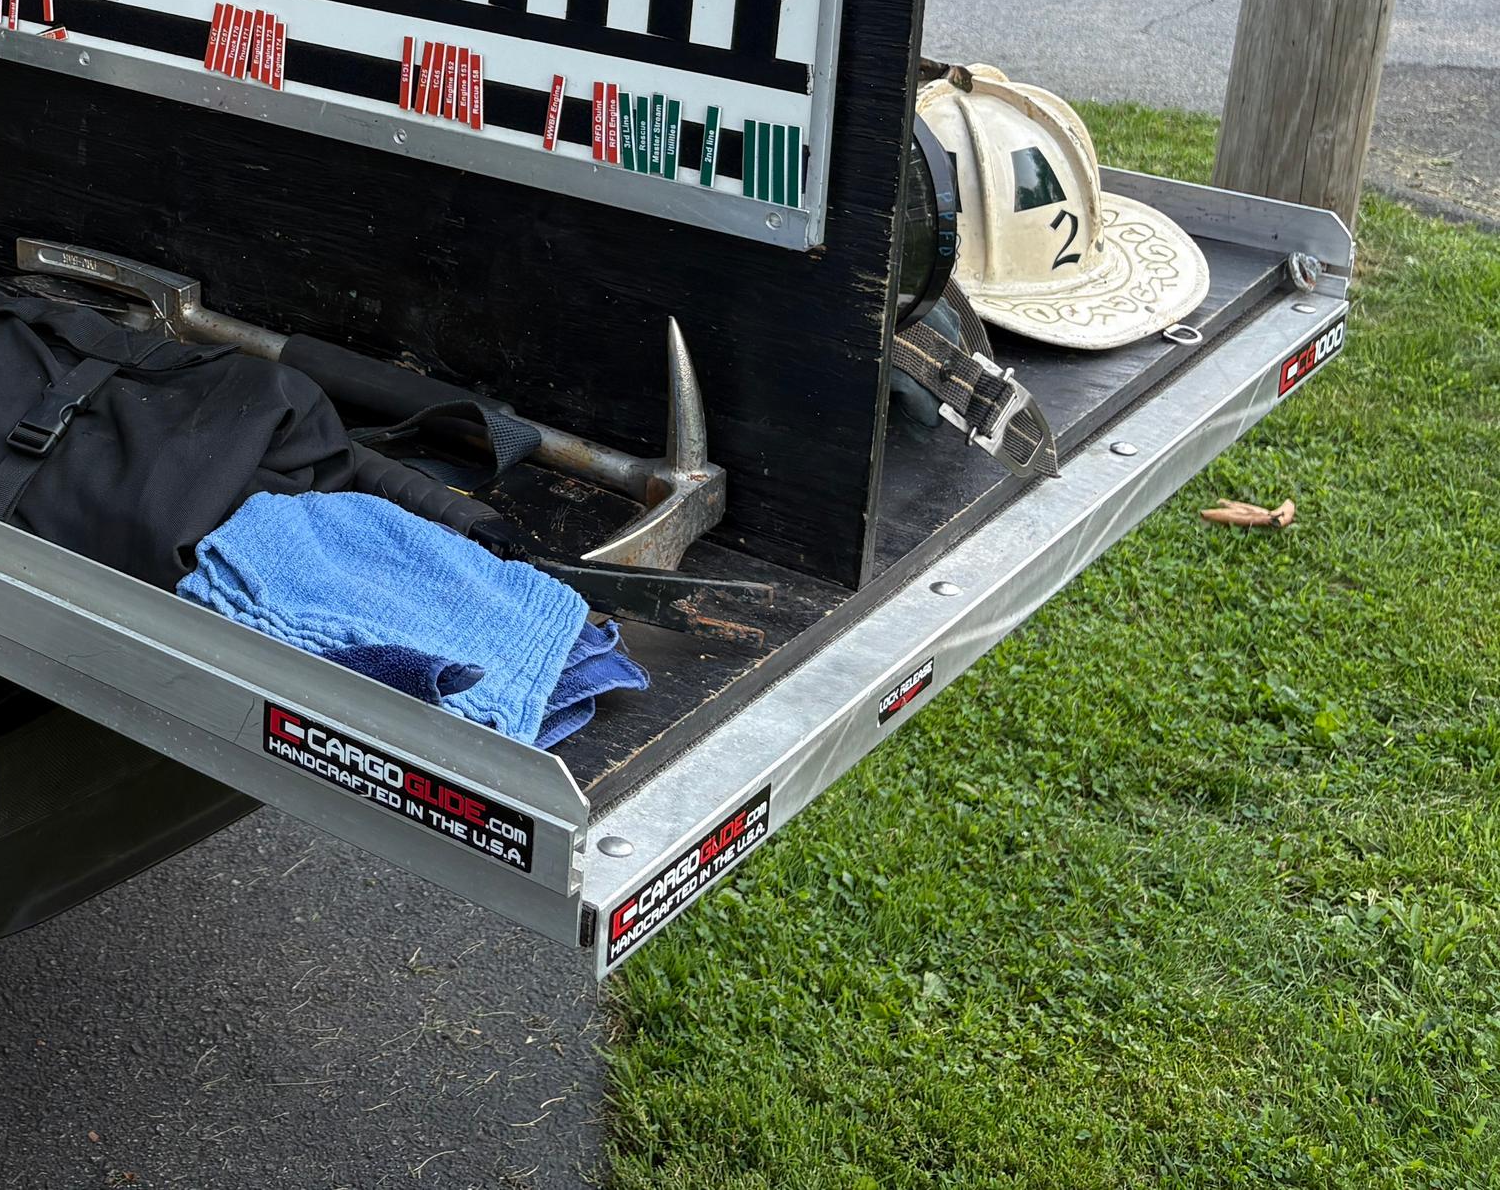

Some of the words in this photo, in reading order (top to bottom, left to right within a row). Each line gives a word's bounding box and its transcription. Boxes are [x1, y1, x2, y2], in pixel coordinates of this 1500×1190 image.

[210, 28, 218, 46] 1C47
[228, 40, 236, 59] Truck
[239, 42, 247, 61] Truck
[264, 43, 272, 69] Engine
[274, 52, 282, 78] Engine
[420, 69, 428, 88] 1C25
[446, 77, 454, 104] Engine
[460, 80, 468, 106] Engine
[472, 85, 480, 114] Rescue
[551, 85, 561, 113] Engine
[594, 100, 602, 123] Quint
[609, 99, 617, 128] Engine
[622, 114, 630, 133] Line
[653, 104, 662, 134] Stream
[594, 124, 602, 142] RFD
[608, 130, 616, 148] RFD
[623, 134, 631, 148] 3rd
[667, 124, 676, 155] Utilities
[706, 130, 714, 146] line
[652, 134, 660, 163] Master
[704, 147, 714, 163] 2nd
[1050, 210, 1081, 270] 2
[880, 688, 900, 714] LOCK
[900, 660, 933, 696] RELEASE
[268, 736, 401, 810] HANDCRAFTED
[406, 799, 424, 821] IN
[428, 809, 468, 842] THE
[472, 830, 526, 868] U.S.A.
[610, 875, 698, 959] HANDCRAFTED
[700, 864, 710, 884] IN
[713, 844, 736, 872] THE
[737, 822, 766, 854] U.S.A.
